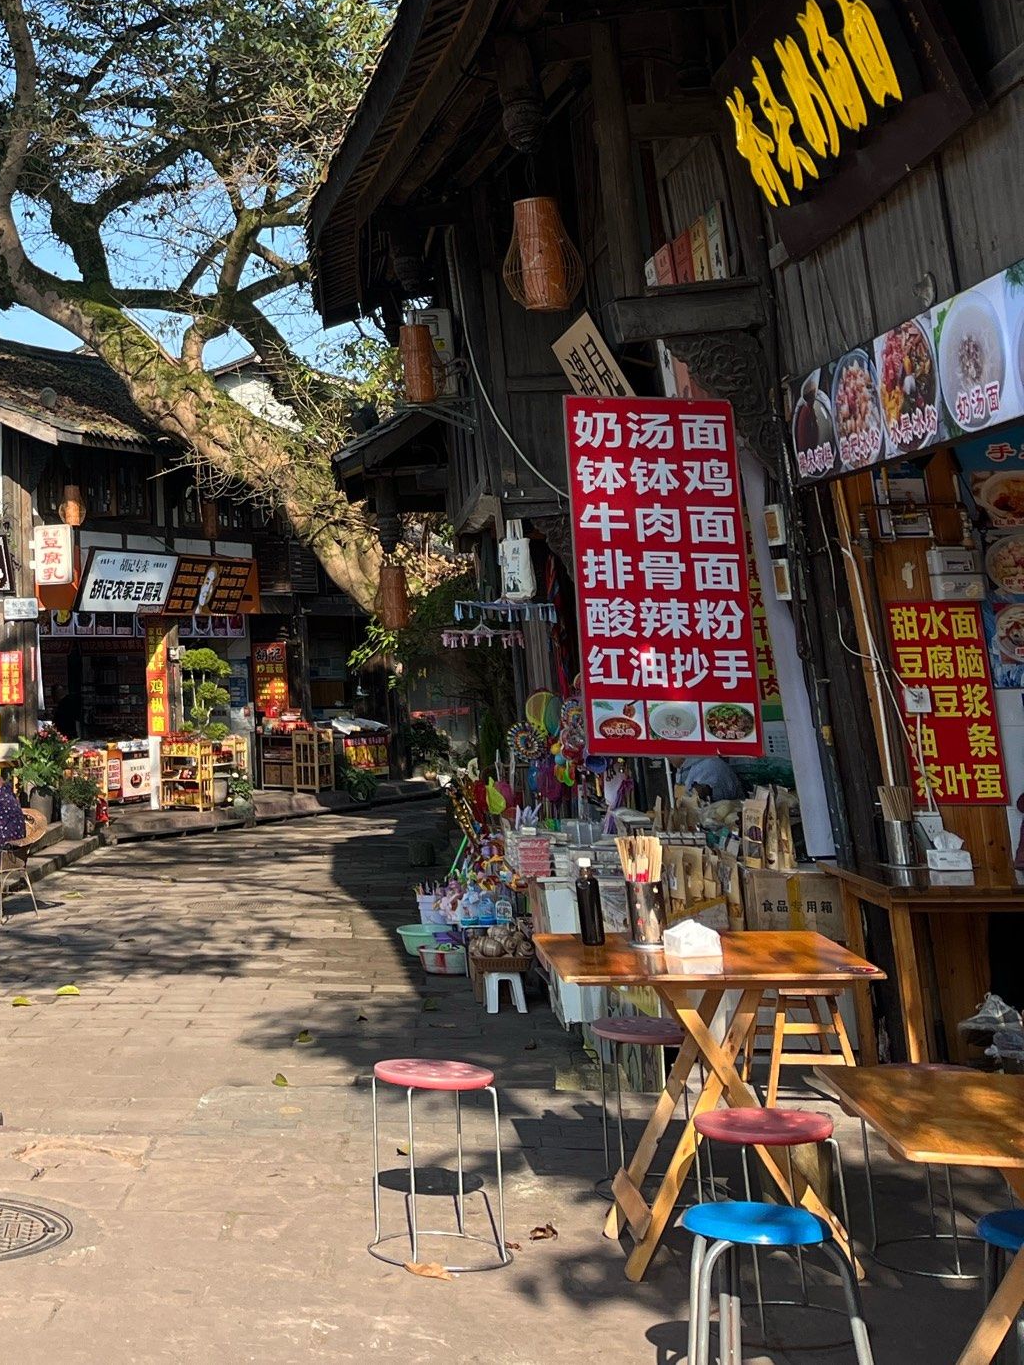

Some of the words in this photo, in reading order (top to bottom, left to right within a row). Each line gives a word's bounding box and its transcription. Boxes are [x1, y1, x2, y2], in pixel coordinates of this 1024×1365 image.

[956, 382, 1000, 423] 奶汤面
[573, 410, 727, 451] 奶汤面
[890, 405, 938, 445] 水果冰粉
[987, 443, 1024, 461] 手
[576, 456, 733, 497] 钵钵鸡
[579, 502, 736, 545] 牛肉面
[40, 537, 65, 580] 豆腐乳
[582, 549, 741, 592] 排骨面
[89, 579, 164, 602] 胡记农家豆腐乳
[584, 597, 745, 640] 酸辣粉
[890, 606, 979, 641] 甜水面
[255, 647, 284, 663] 胡记
[588, 645, 753, 690] 红油抄手
[896, 645, 986, 679] 豆腐脑
[905, 684, 992, 719] 豆浆
[914, 763, 1005, 799] 茶叶蛋
[761, 899, 833, 914] 食品专用箱
